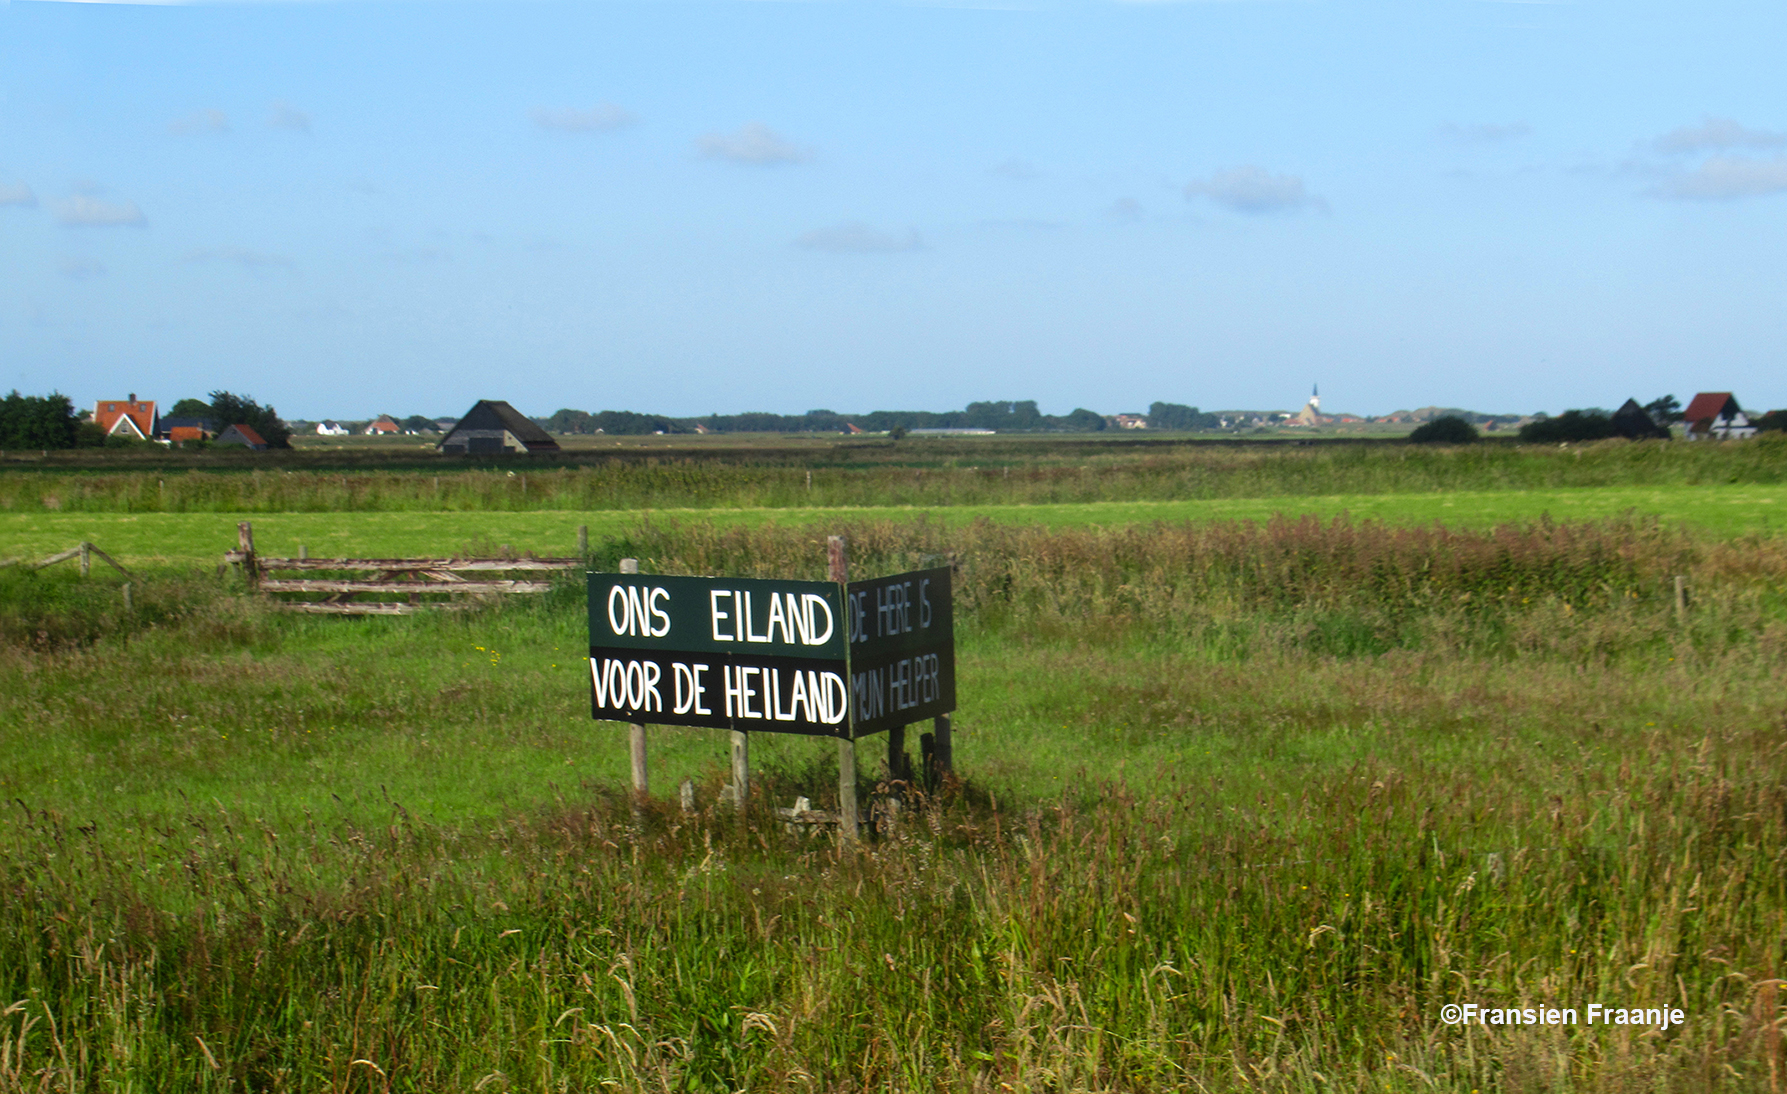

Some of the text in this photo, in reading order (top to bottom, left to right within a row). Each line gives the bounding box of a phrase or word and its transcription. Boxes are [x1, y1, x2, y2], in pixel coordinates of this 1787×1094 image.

[608, 585, 834, 645] ONS EILAND
[849, 578, 932, 643] DE HERE IS
[590, 657, 847, 724] VOOR DE HEILAND
[890, 653, 940, 711] HELPER
